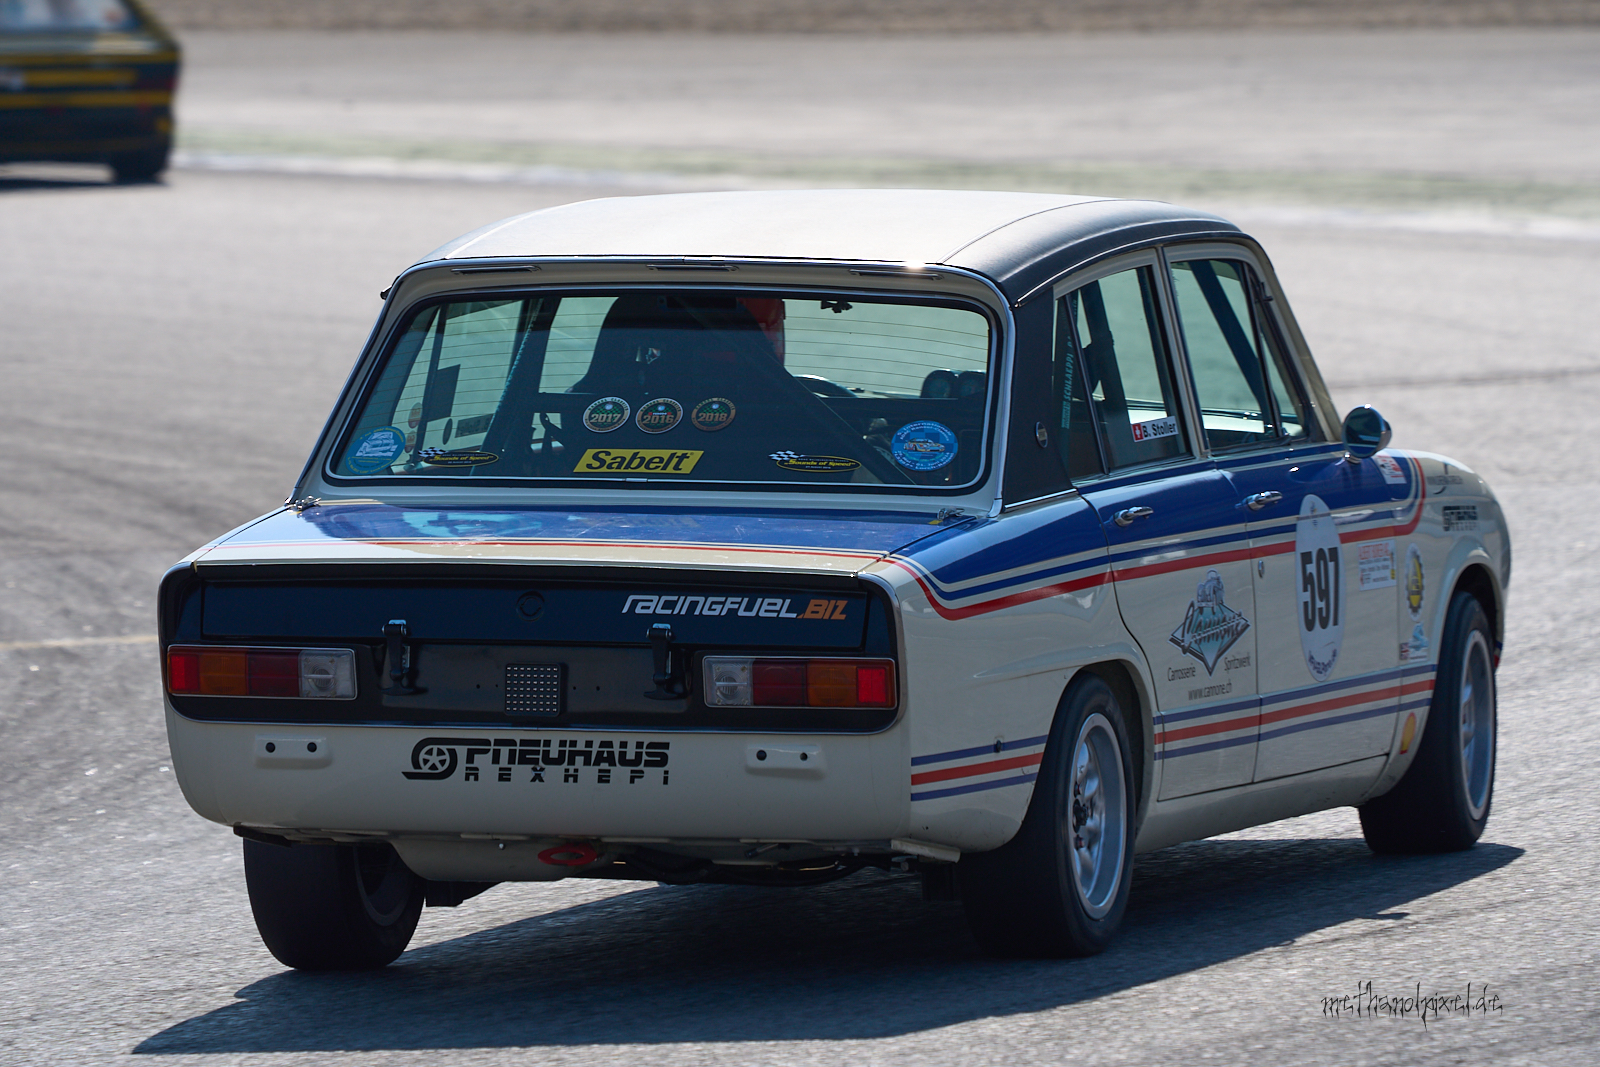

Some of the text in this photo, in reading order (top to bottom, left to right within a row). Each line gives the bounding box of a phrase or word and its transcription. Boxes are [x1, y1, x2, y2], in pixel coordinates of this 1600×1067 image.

[1063, 352, 1074, 401] SCHLAEPPI
[589, 413, 622, 423] 2017
[642, 414, 675, 424] 2016
[697, 412, 728, 422] 2018
[1143, 422, 1176, 438] B. Stoller
[586, 450, 690, 471] Sabelt
[1299, 546, 1339, 632] 597
[465, 738, 671, 768] PNEUHAUS
[464, 766, 670, 785] REXHEPI
